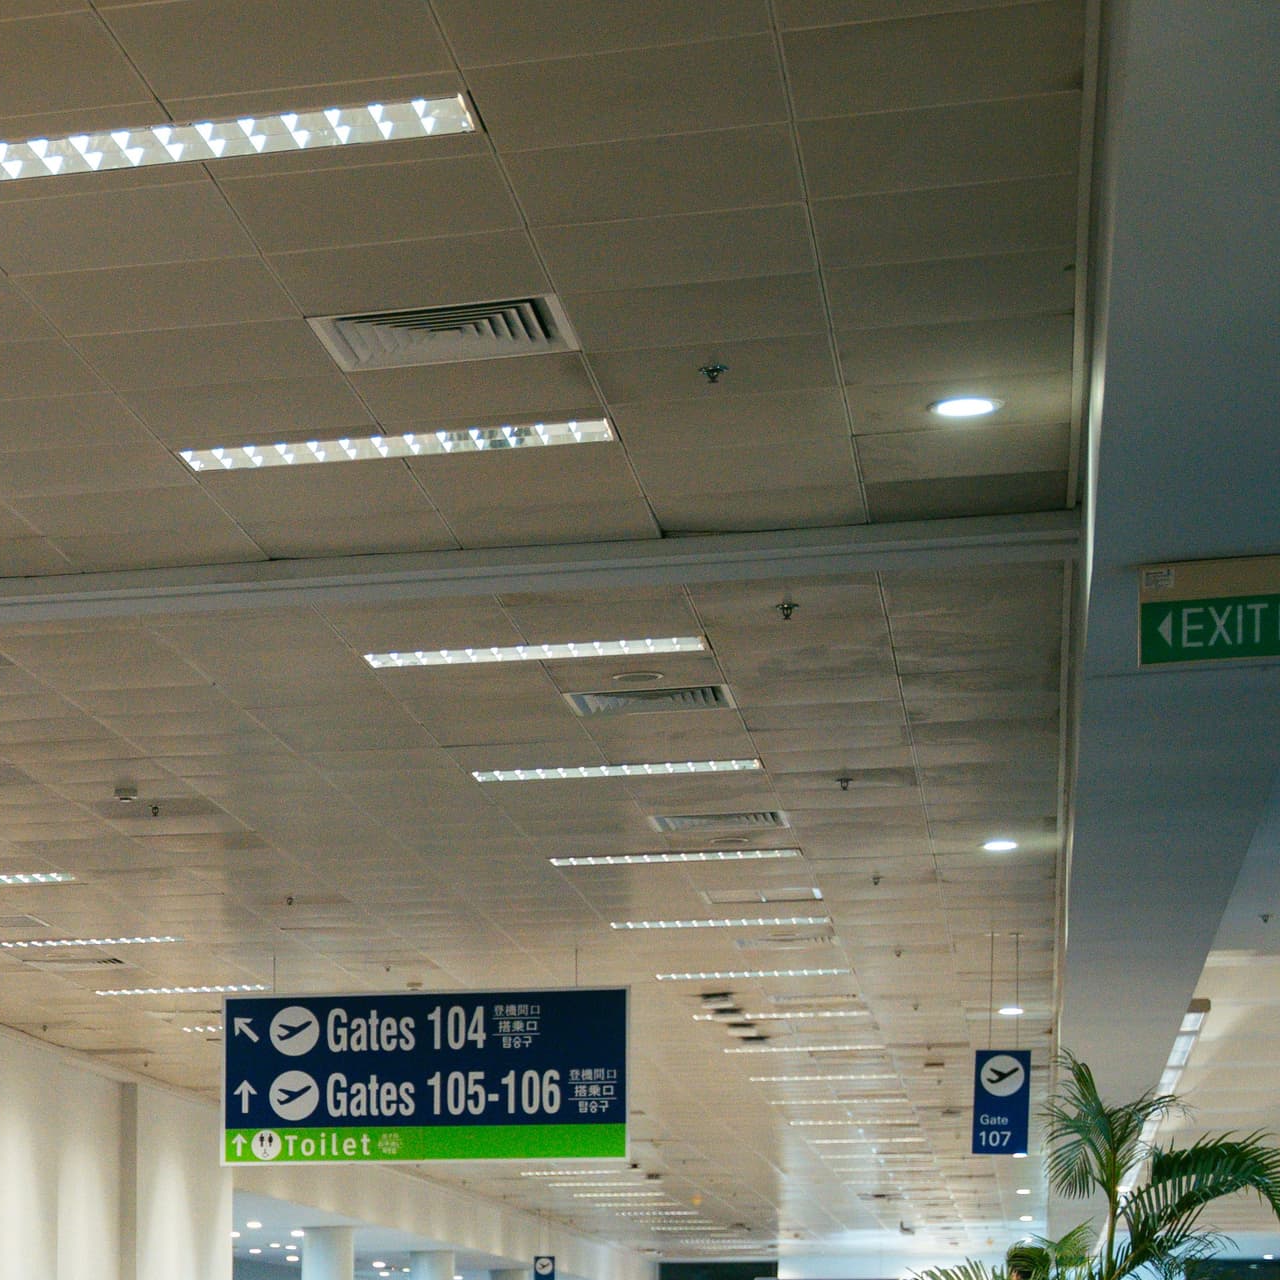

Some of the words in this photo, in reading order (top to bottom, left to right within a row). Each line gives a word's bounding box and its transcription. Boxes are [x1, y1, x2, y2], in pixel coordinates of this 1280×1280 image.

[1182, 603, 1268, 648] EXIT
[326, 1007, 416, 1053] Gates
[427, 1005, 487, 1050] 104
[326, 1072, 416, 1118] Gates
[427, 1069, 561, 1116] 105-106
[979, 1113, 1009, 1126] Gate
[284, 1132, 371, 1157] Toilet
[979, 1130, 1012, 1147] 107
